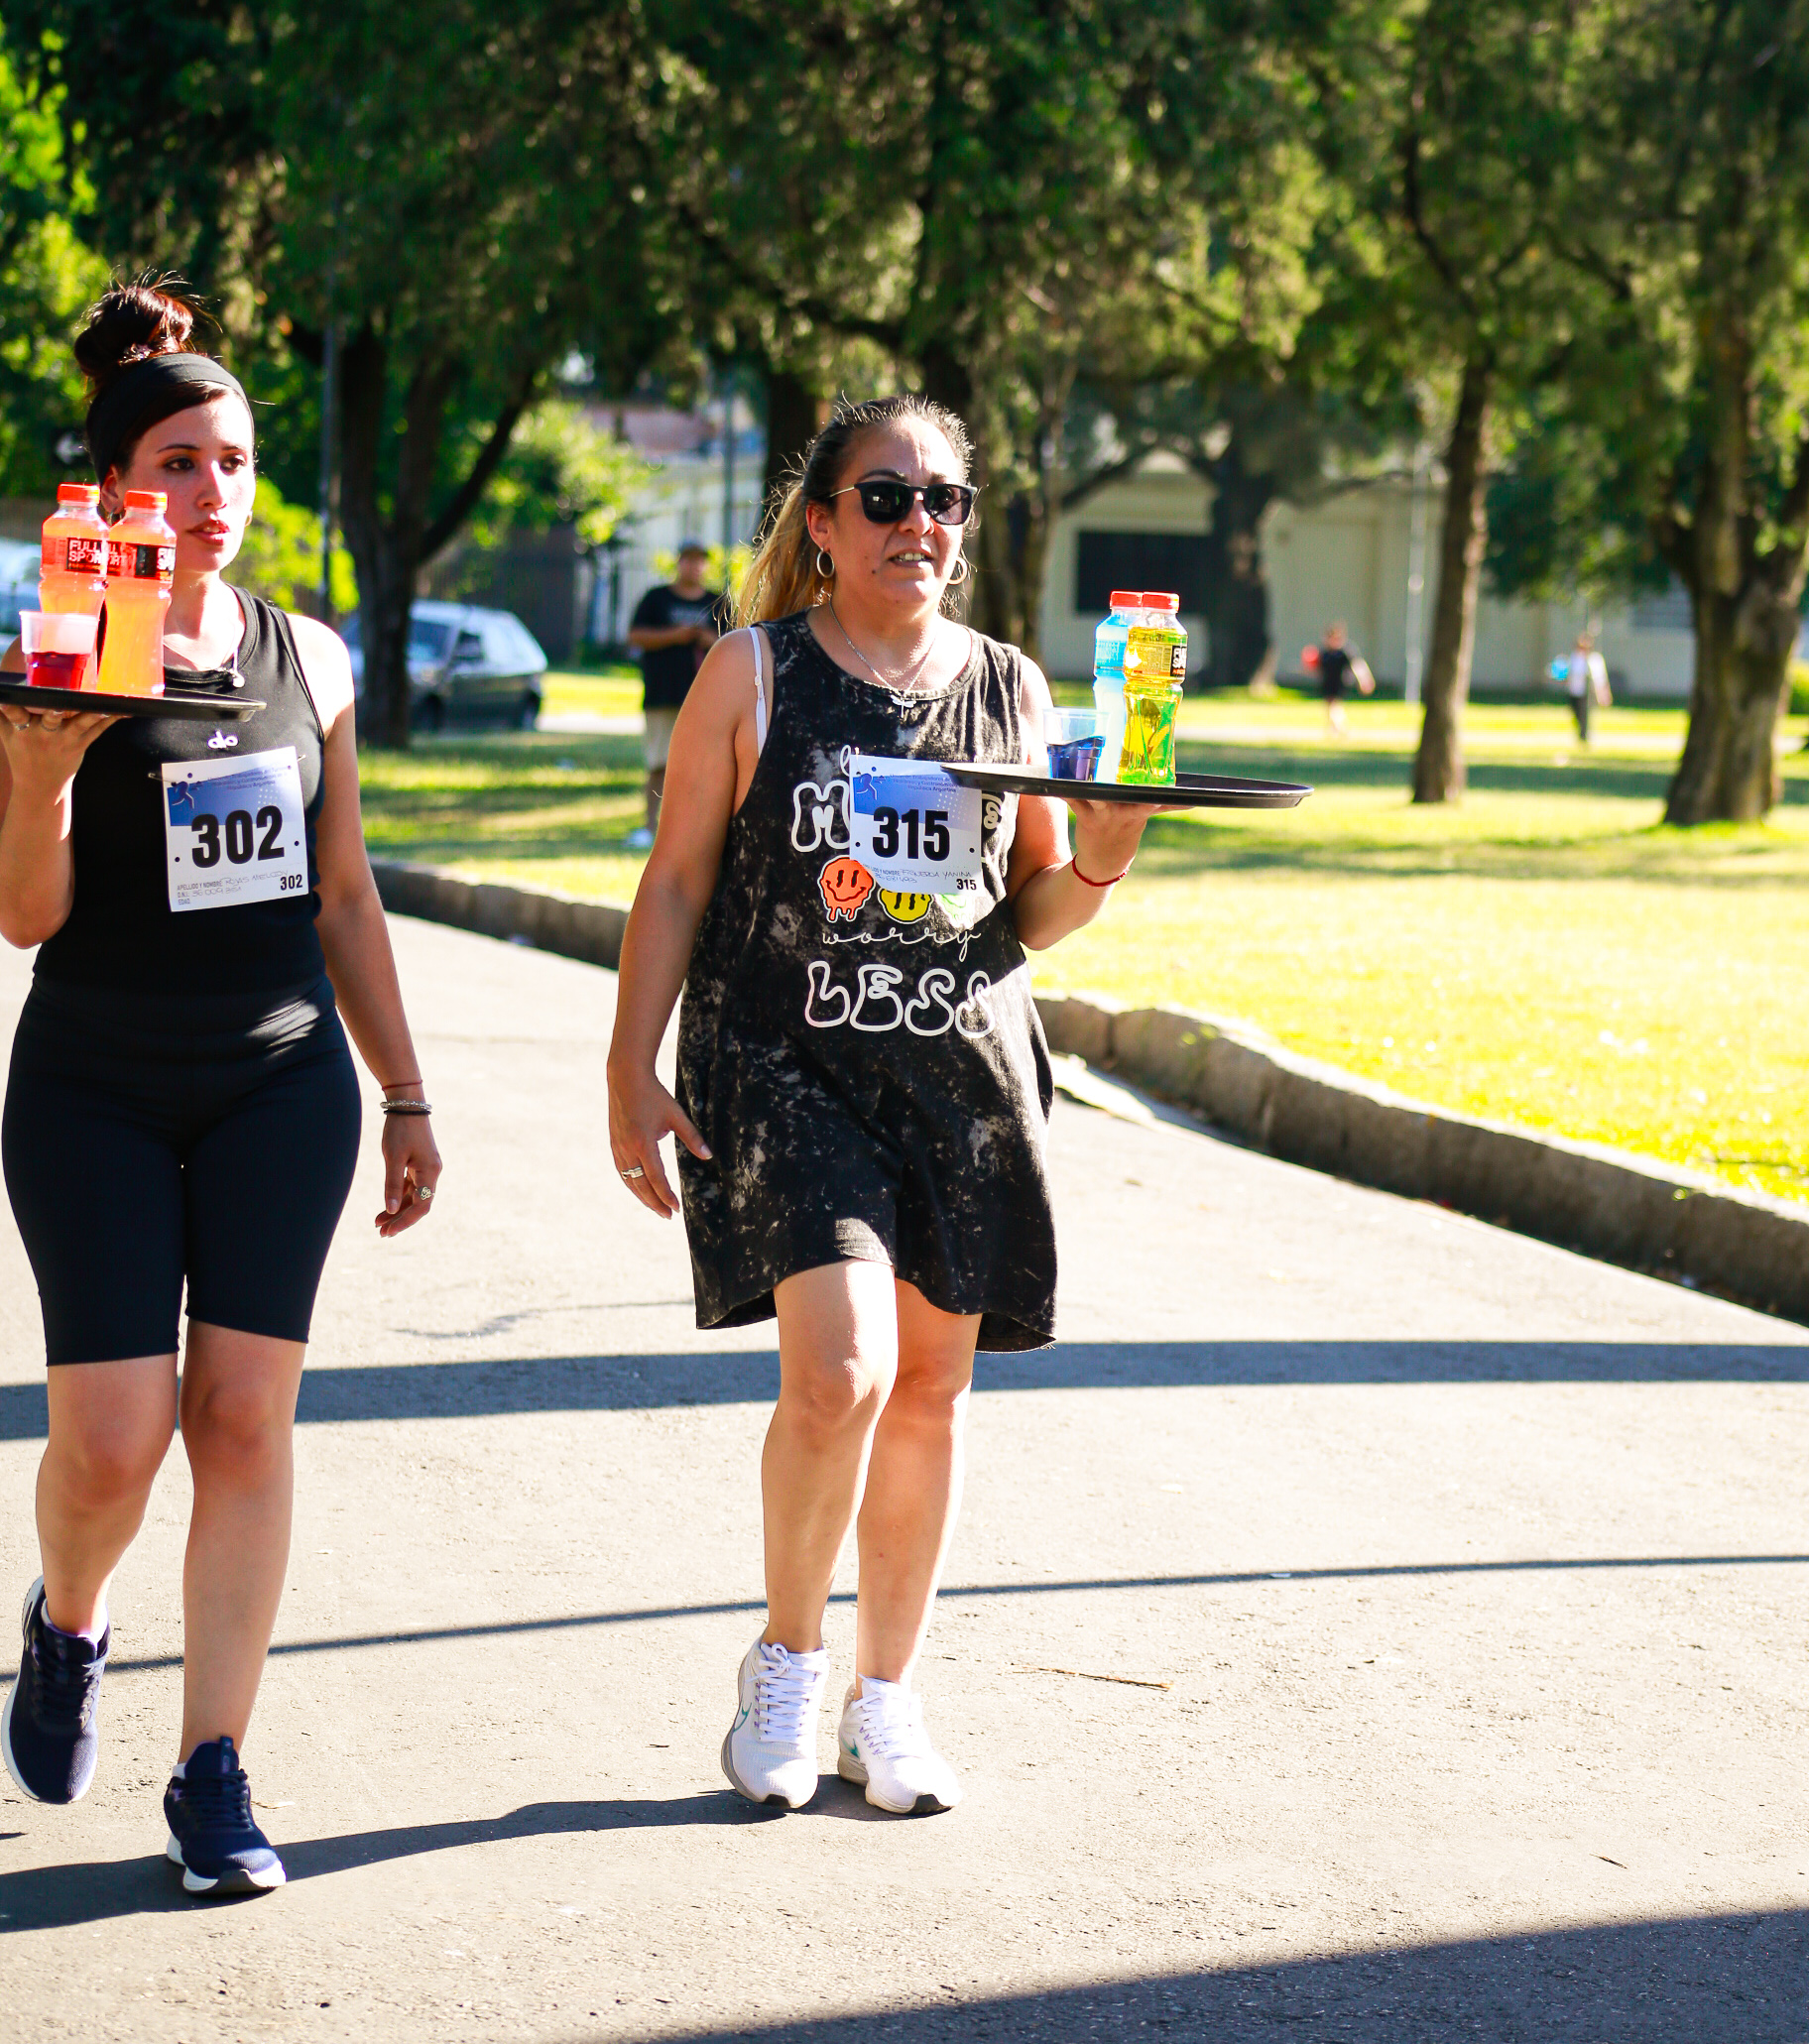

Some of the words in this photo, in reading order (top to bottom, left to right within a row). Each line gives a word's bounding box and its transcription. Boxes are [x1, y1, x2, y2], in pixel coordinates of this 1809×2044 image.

[67, 550, 102, 564] SPOR
[191, 805, 286, 868] 302
[872, 806, 951, 862] 315
[280, 874, 303, 892] 302
[956, 879, 978, 891] 315
[822, 926, 982, 962] worry
[804, 960, 995, 1039] LESS
